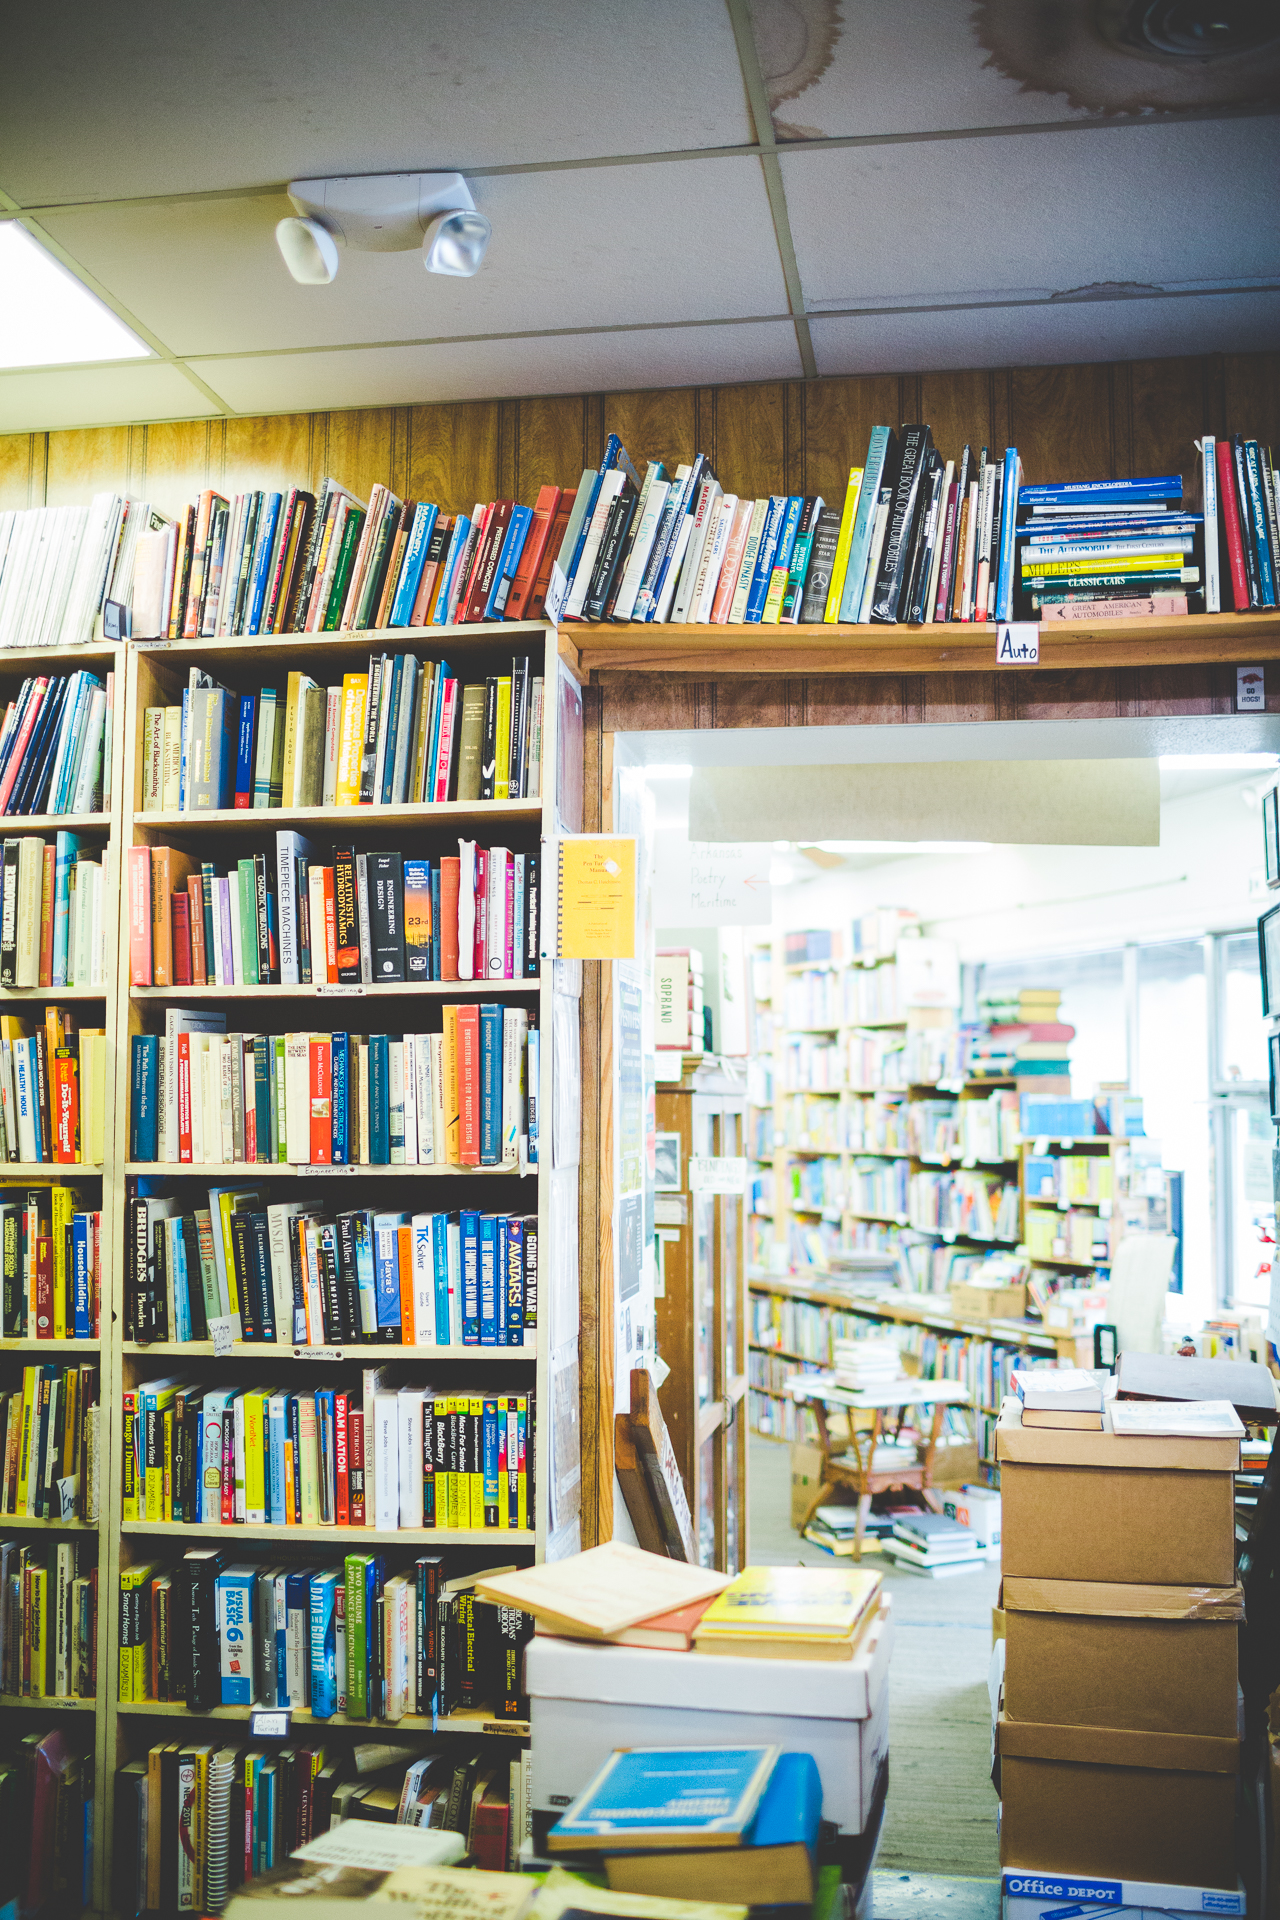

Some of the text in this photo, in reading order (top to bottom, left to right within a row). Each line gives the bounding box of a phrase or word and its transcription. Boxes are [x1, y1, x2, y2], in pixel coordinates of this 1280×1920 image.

[850, 472, 861, 486] 2
[694, 486, 710, 528] MARQUES
[885, 432, 920, 572] THE GREAT BOOK OF AUTOMOBILES
[582, 516, 591, 536] JUNIPER
[716, 519, 724, 542] SALOON
[317, 518, 334, 574] MASONRY
[481, 527, 503, 592] PRESTRESSED CONCRETE
[739, 536, 758, 590] DODGE DYNASTY
[790, 543, 806, 573] DIVIDED HIGHWAYS
[1038, 547, 1055, 555] THE
[1058, 544, 1112, 554] AUTOMOBILE
[1028, 562, 1082, 576] MILLER'S
[1068, 577, 1126, 587] CLASSIC CARS
[1072, 610, 1123, 618] AUTOMOBILES
[1104, 601, 1142, 609] AMERICAN
[1000, 628, 1036, 660] Auto
[372, 664, 380, 706] ENGINEERING
[154, 741, 160, 749] of
[350, 689, 365, 787] Dangerous Properties
[151, 750, 160, 798] Blacksmithing
[690, 843, 743, 859] Arkansas
[344, 864, 354, 928] RELATIVISTIC
[691, 867, 726, 889] Poetry
[2, 865, 16, 941] RENOVATION
[257, 875, 268, 949] CHAOTIC VIBRATIONS
[281, 846, 291, 964] TIMEPIECE MACHINES
[336, 864, 347, 945] HYDRODYNAMICS
[387, 880, 395, 935] ENGINEERING
[691, 893, 737, 909] Maritime
[322, 986, 358, 994] Engineering
[661, 977, 672, 1024] SOPRANO
[61, 1083, 70, 1153] Do-It-Yourself
[305, 1166, 348, 1176] Engineering
[137, 1206, 147, 1282] BRIDGES
[198, 1218, 214, 1260] THE GATE
[258, 1234, 266, 1277] ELEMENTARY
[342, 1219, 352, 1263] Paul Allen
[76, 1241, 86, 1312] Housebuilding
[309, 1252, 318, 1289] SHALLOWS
[508, 1241, 522, 1307] AVATARS!
[526, 1236, 537, 1312] GOING TO WAR
[138, 1292, 147, 1328] Plowden
[241, 1278, 249, 1316] SURVEYING
[300, 1350, 335, 1358] Engineering
[336, 1398, 347, 1473] SPAM NATION
[436, 1422, 445, 1464] BlackBerry
[125, 1451, 133, 1493] Dummies
[226, 1590, 244, 1642] BASIC 6
[235, 1590, 243, 1626] VISUAL
[264, 1639, 272, 1660] Jony
[467, 1631, 475, 1672] Electrical
[255, 1715, 279, 1724] Alan
[255, 1725, 280, 1734] Turing
[489, 1726, 517, 1734] Appliances
[589, 1808, 731, 1819] MICROECONOMIC
[668, 1797, 731, 1808] THEORY
[302, 1829, 306, 1838] OF
[1010, 1879, 1115, 1900] Office DEPOT
